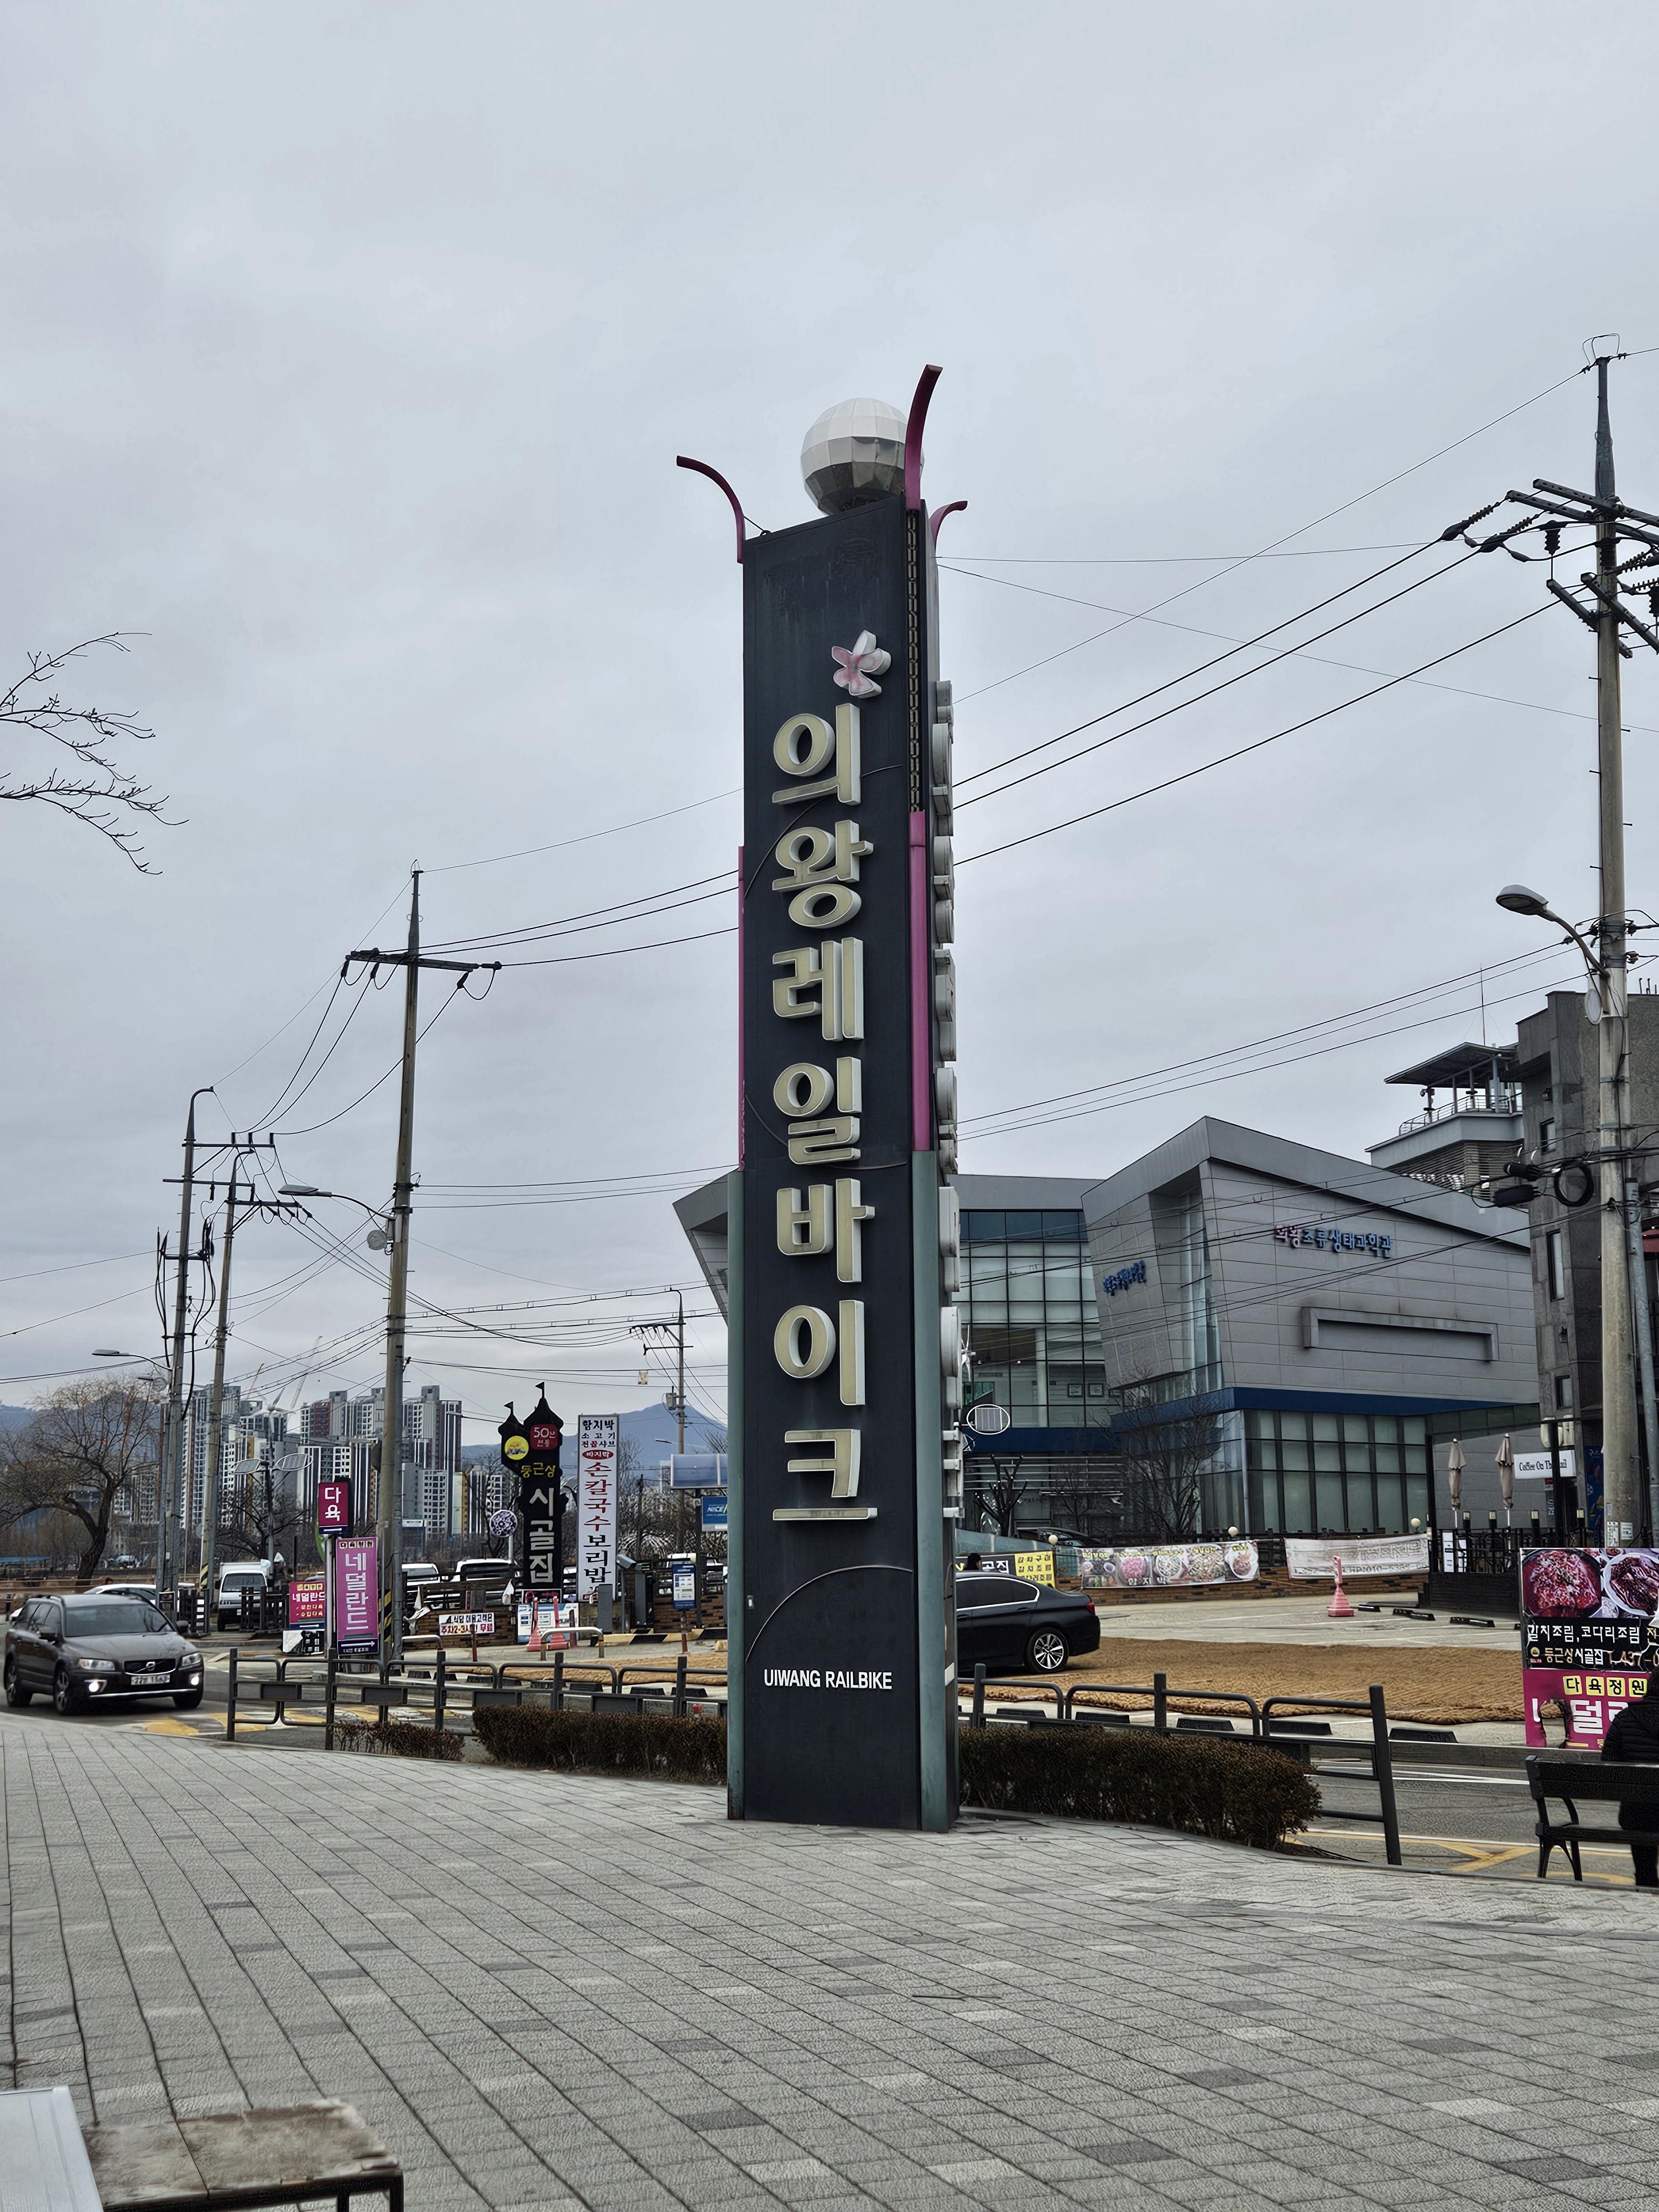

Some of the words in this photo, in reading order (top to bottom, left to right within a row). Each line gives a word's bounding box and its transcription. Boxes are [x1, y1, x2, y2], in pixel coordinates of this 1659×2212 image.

[772, 703, 878, 1521] 의왕레일바이크
[325, 1486, 342, 1521] 다육
[529, 1488, 554, 1583] 시골집
[345, 1552, 369, 1631] 네덜란드
[764, 1669, 821, 1687] UIWANG
[826, 1670, 893, 1689] RAILBIKE
[1565, 1677, 1646, 1696] 다육정원
